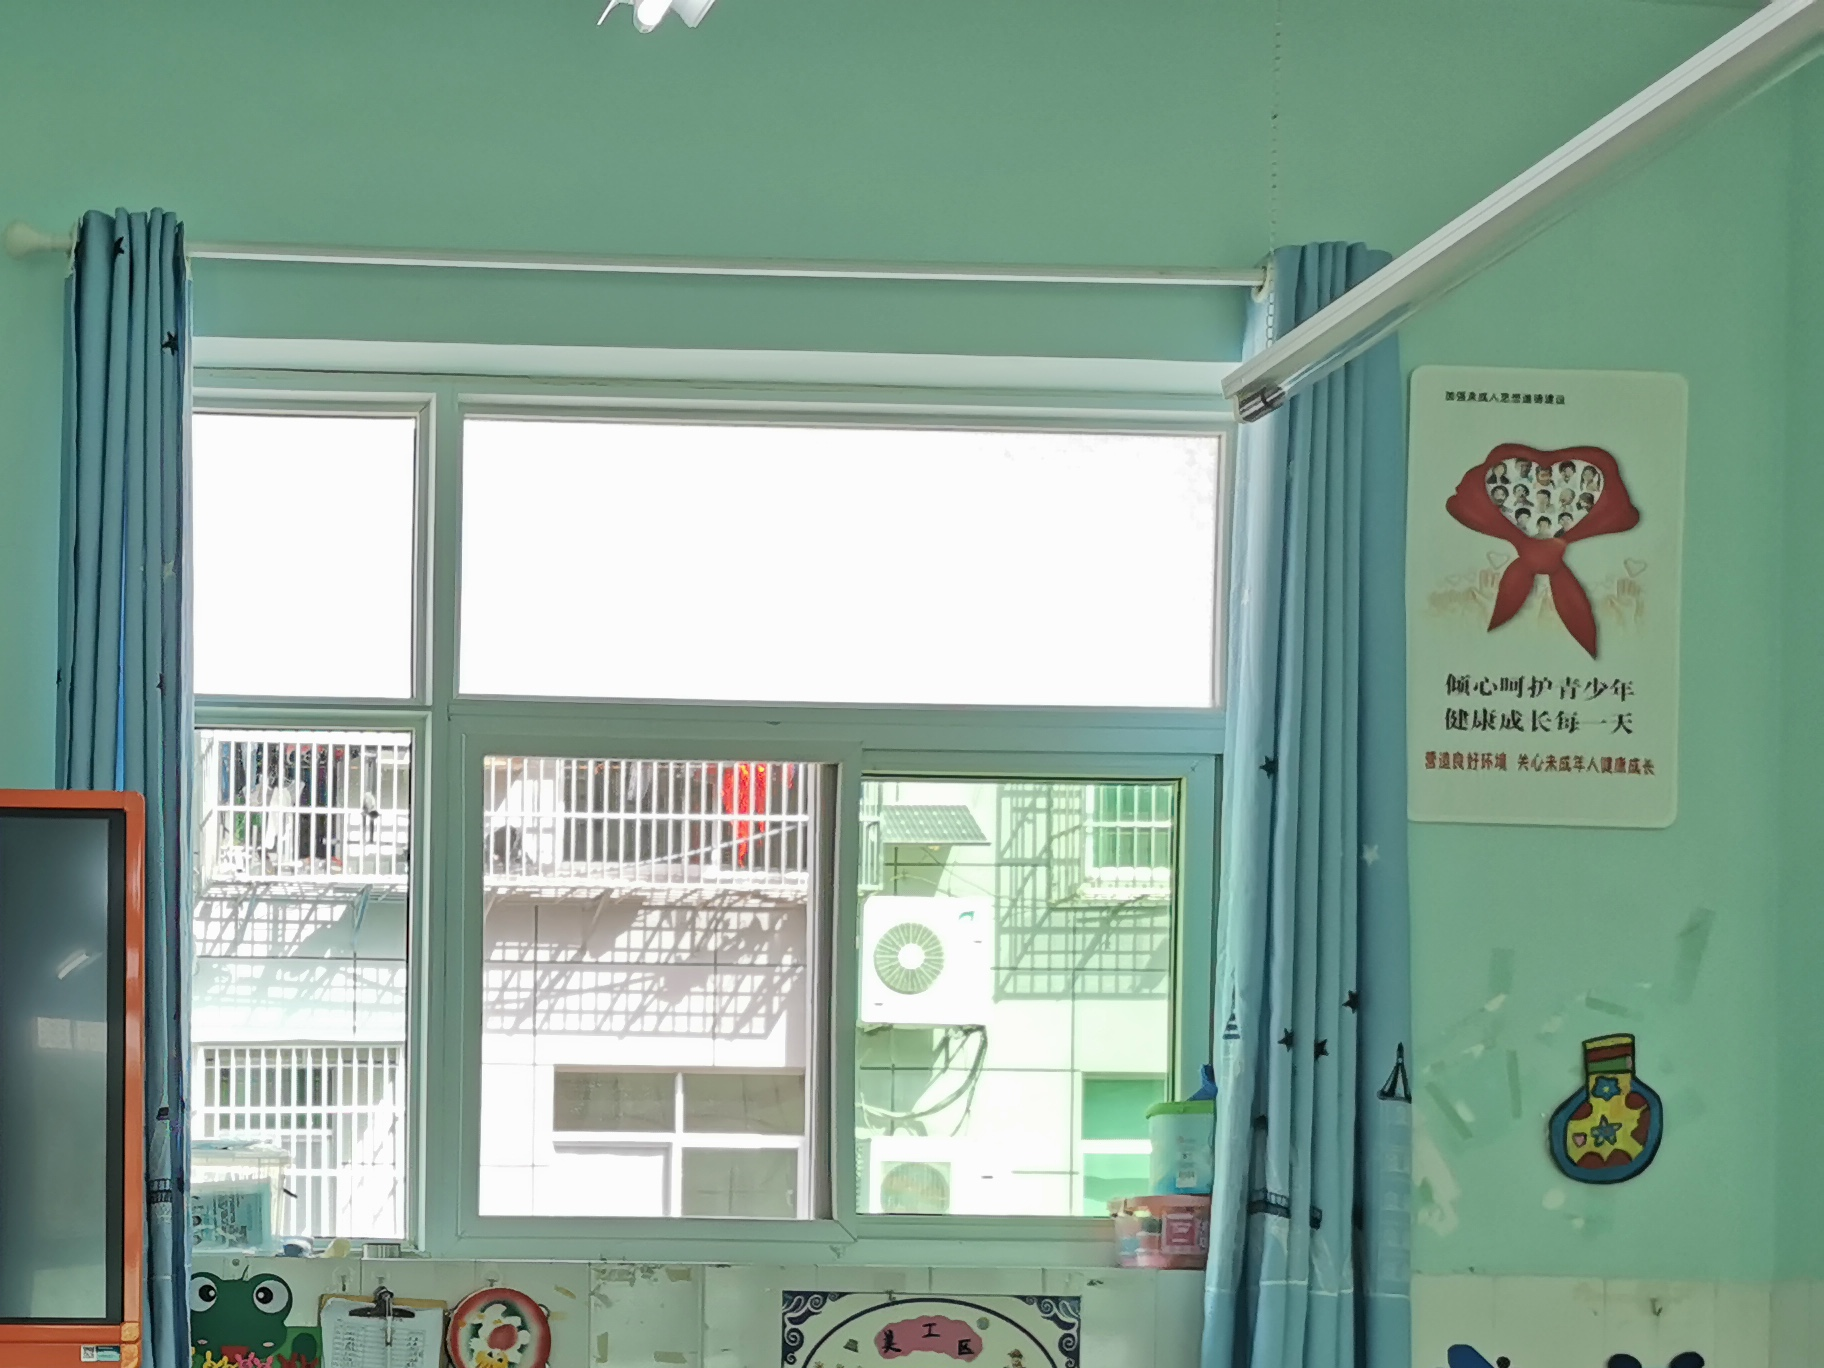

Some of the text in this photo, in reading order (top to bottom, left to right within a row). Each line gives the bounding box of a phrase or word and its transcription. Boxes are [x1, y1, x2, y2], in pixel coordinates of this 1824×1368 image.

[1445, 673, 1634, 702] 倾心呵护青少年
[1445, 707, 1633, 734] 健康成长每一天
[1425, 750, 1656, 775] 营造良好环境 关心未成年人健康成长
[882, 1322, 975, 1356] 美工区
